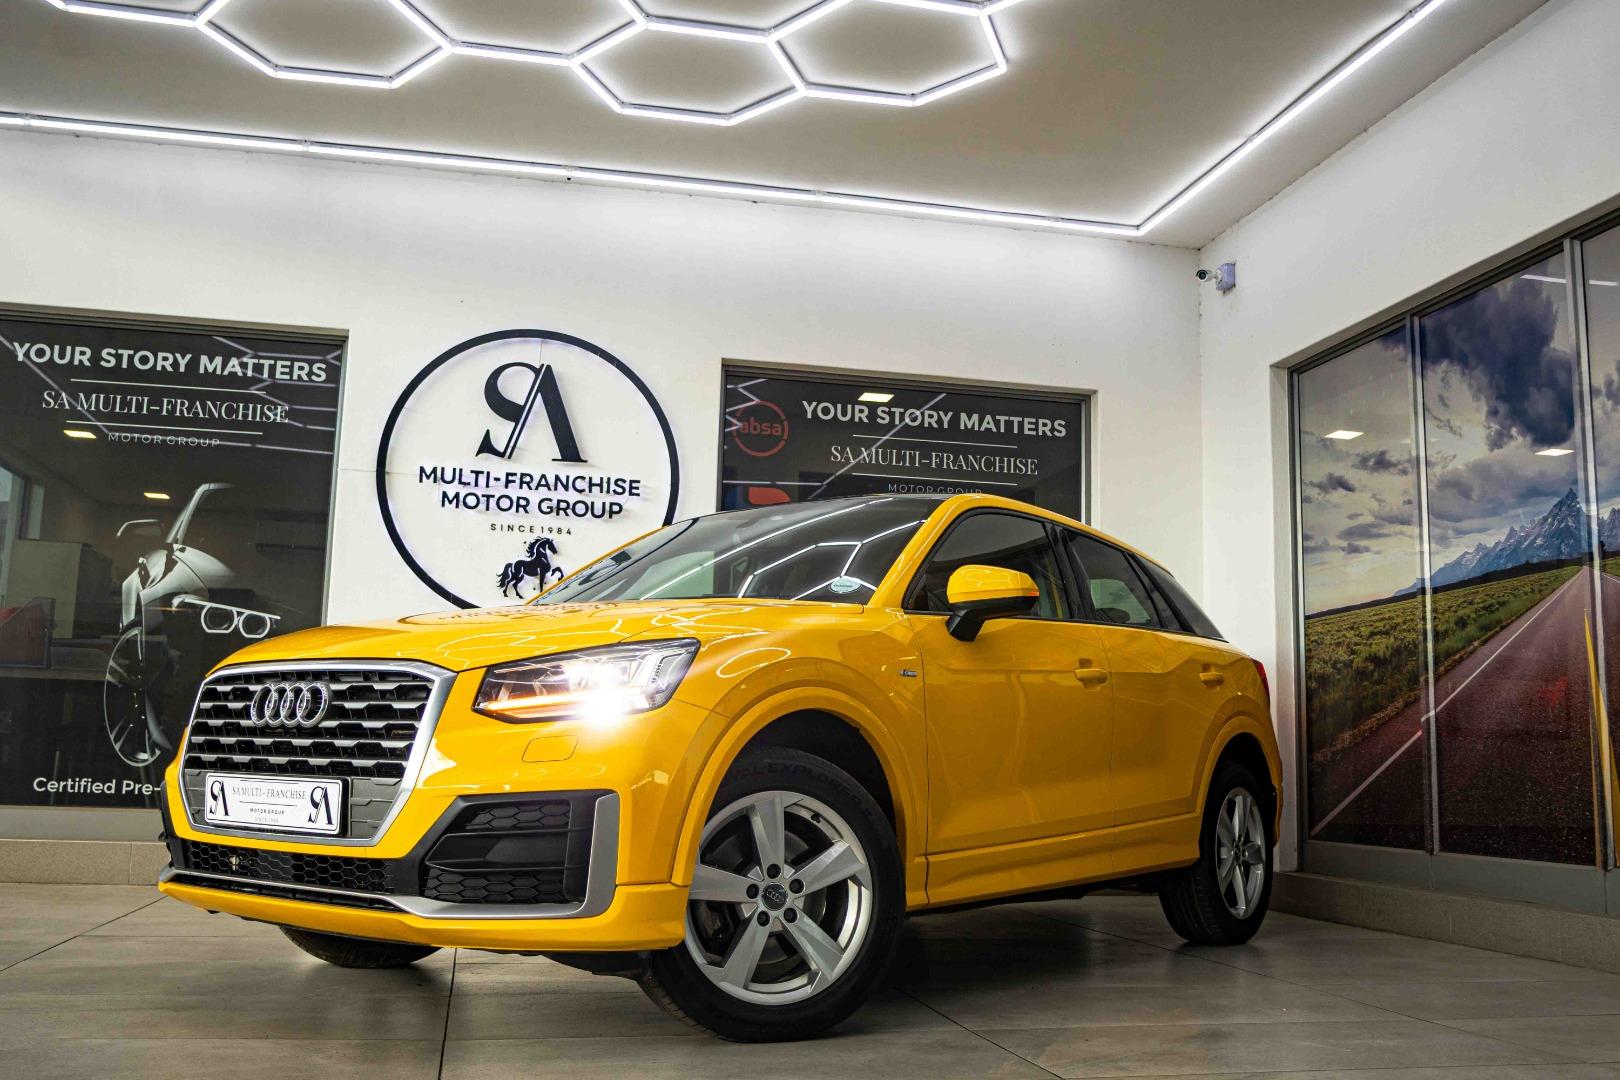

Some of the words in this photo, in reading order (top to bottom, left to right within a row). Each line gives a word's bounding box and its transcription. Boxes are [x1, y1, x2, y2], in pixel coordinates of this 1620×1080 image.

[13, 341, 91, 367] YOUR
[100, 348, 192, 373] STORY
[199, 355, 327, 382] MATTERS
[42, 390, 71, 410] SA
[77, 392, 289, 423] MULTI-FRANCHISE
[801, 400, 869, 423] YOUR
[876, 407, 953, 429] STORY
[959, 412, 1067, 438] MATTERS
[108, 432, 162, 445] MOTOR
[166, 435, 220, 447] GROUP
[739, 416, 782, 436] absa
[830, 445, 854, 462] SA
[860, 447, 1038, 475] MULTI-FRANCHISE
[418, 465, 641, 497] MULTI-FRANCHISE
[888, 483, 934, 494] MOTOR
[441, 491, 530, 514] MOTOR
[537, 496, 623, 519] GROUP
[490, 522, 536, 534] SINCE
[540, 526, 572, 536] 1984
[33, 776, 116, 795] Certified
